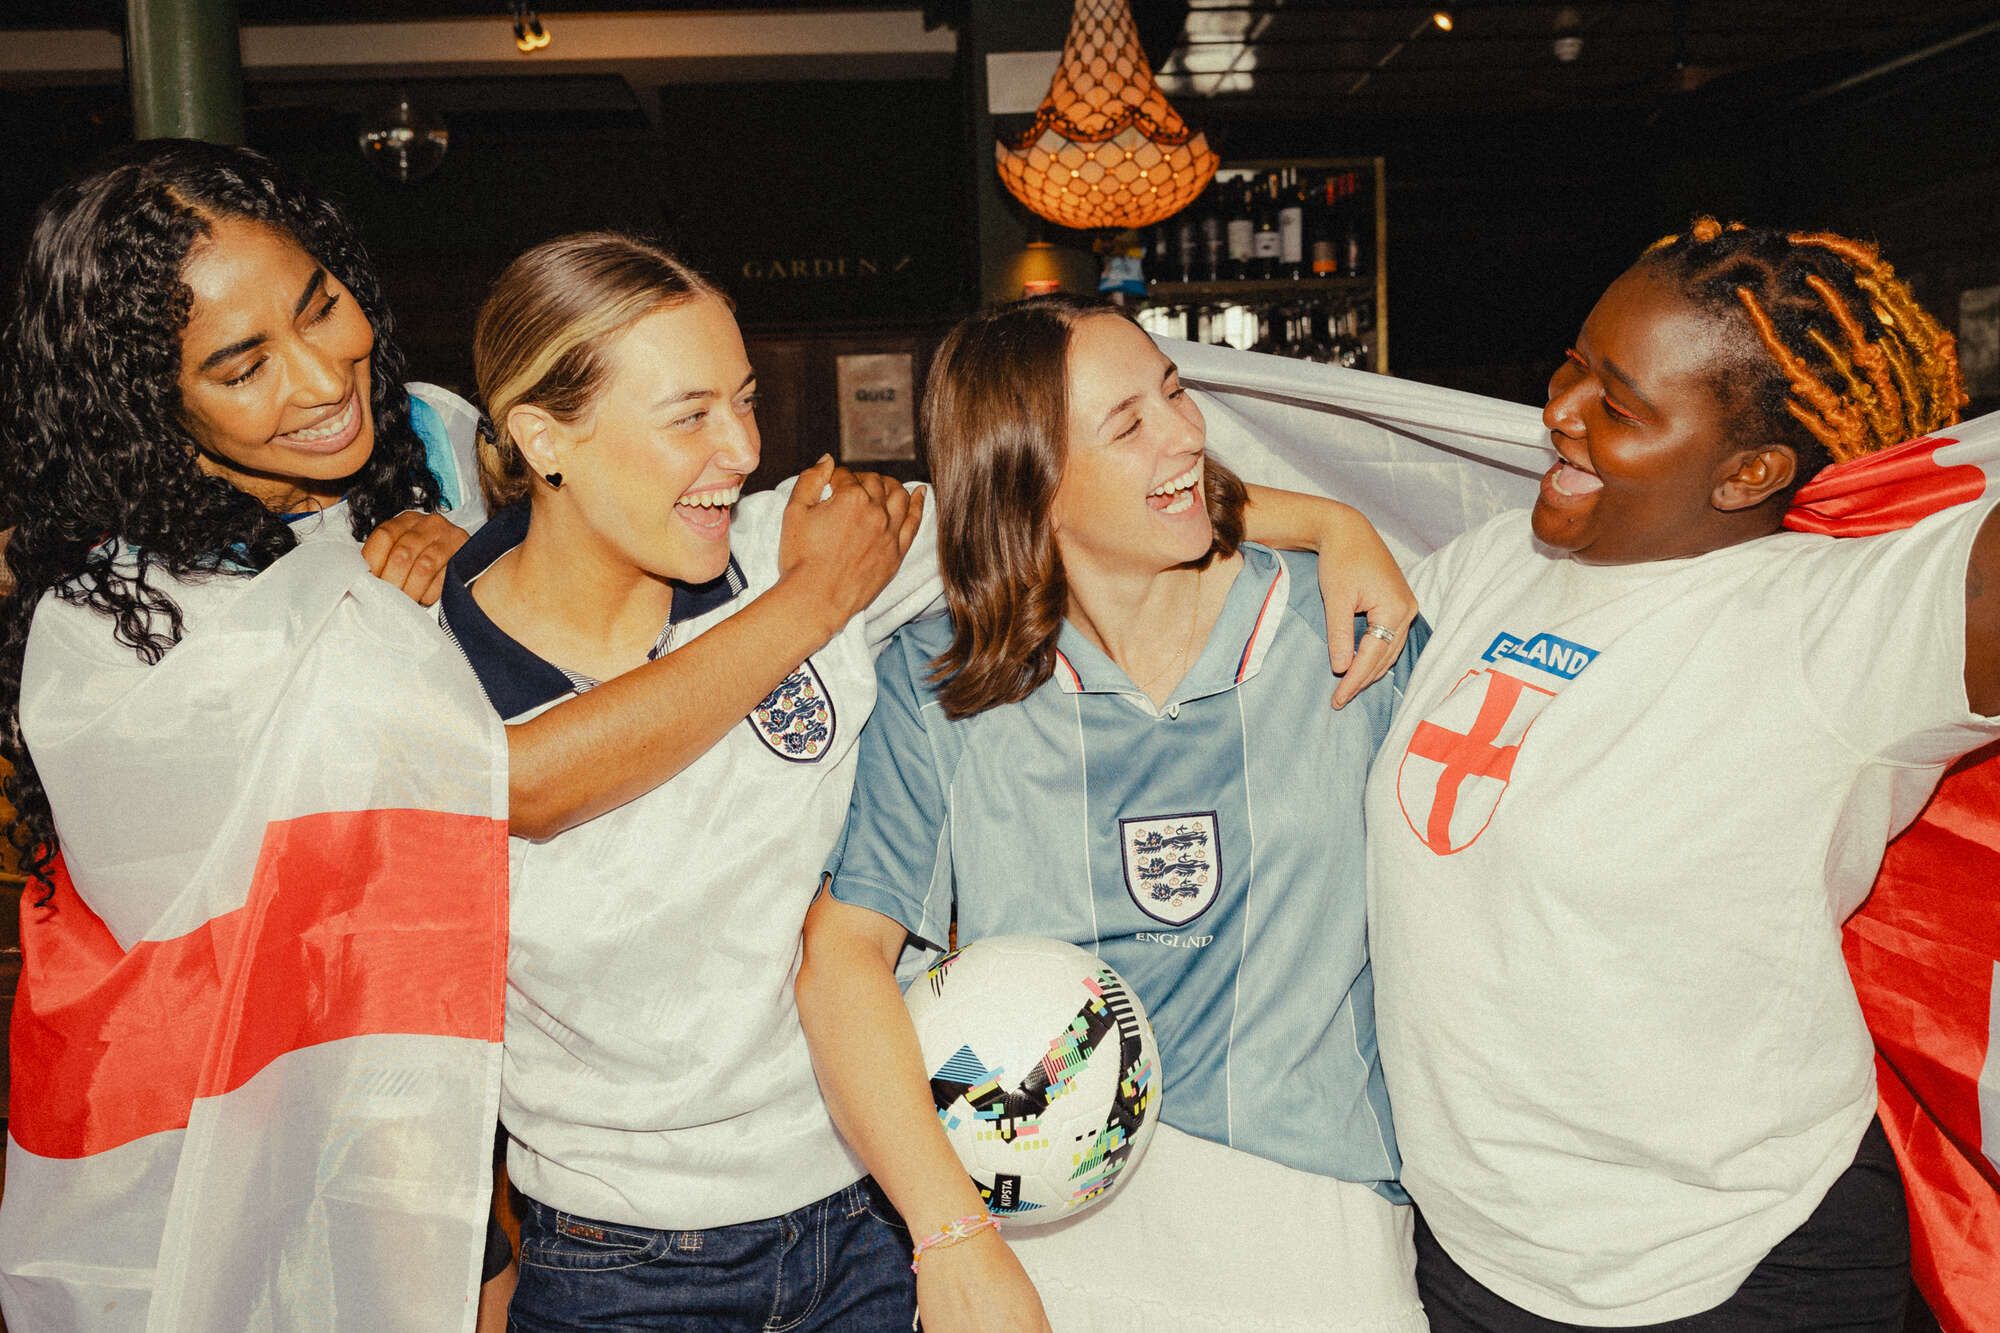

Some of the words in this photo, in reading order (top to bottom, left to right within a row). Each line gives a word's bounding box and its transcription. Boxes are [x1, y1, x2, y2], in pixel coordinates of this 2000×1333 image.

[742, 257, 878, 280] GARDEN
[1490, 638, 1590, 675] ELAND
[1000, 1179, 1013, 1207] KIPSTA
